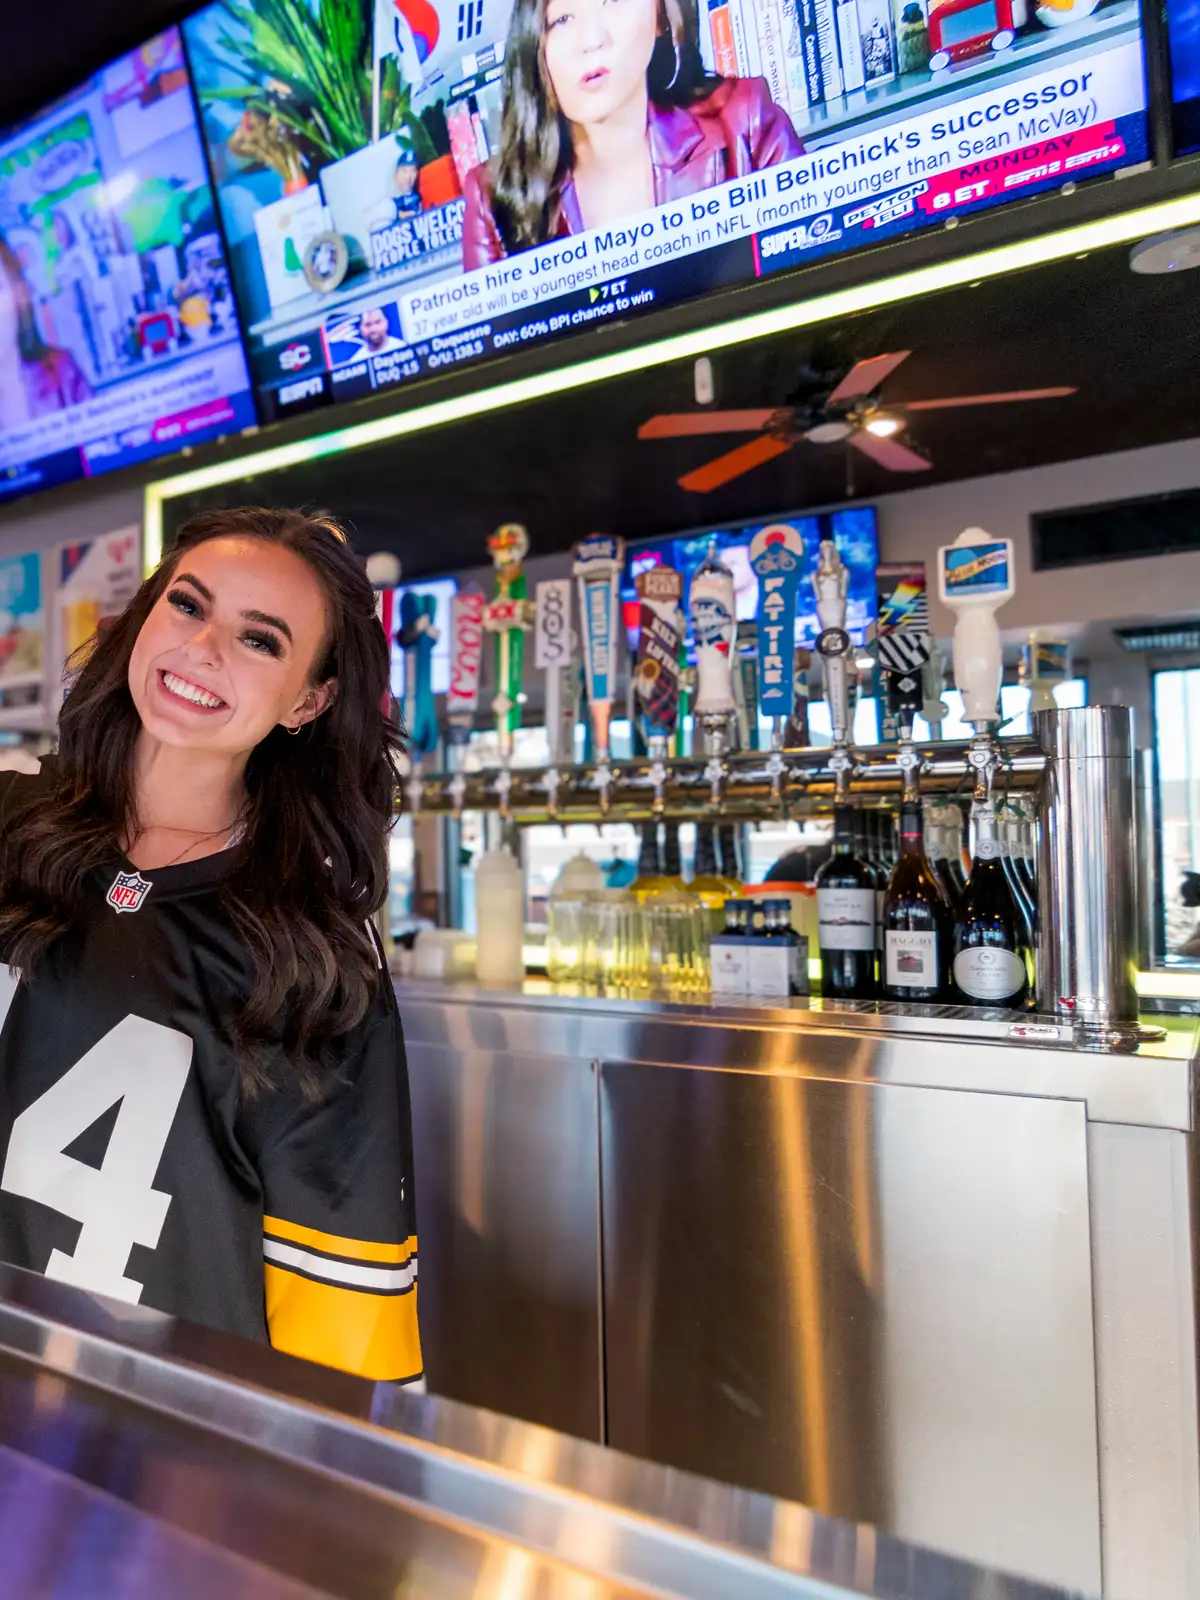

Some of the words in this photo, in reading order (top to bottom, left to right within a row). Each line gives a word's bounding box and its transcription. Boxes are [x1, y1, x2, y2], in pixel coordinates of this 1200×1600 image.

[959, 134, 1076, 181] MONDAY
[410, 282, 480, 315] Patriots
[486, 268, 522, 291] hire
[529, 241, 587, 275] Jerod
[594, 223, 654, 253] Mayo
[661, 212, 684, 231] to
[691, 200, 720, 220] be
[728, 178, 767, 208] Bill
[776, 132, 921, 192] Belichick's
[931, 71, 1092, 140] successor
[848, 182, 926, 223] PEYTON
[932, 192, 952, 209] 8
[955, 179, 990, 204] ET
[1004, 159, 1061, 188] ESPN2
[372, 222, 414, 253] DOGS
[413, 200, 466, 239] WELCO
[413, 319, 429, 336] 37
[433, 311, 458, 332] year
[462, 302, 483, 320] old
[486, 294, 508, 312] will
[511, 288, 529, 303] be
[532, 264, 598, 300] youngest
[601, 251, 639, 276] head
[644, 233, 691, 261] coach
[696, 228, 711, 244] in
[717, 213, 751, 237] NFL
[756, 189, 818, 226] (month
[823, 166, 901, 210] younger
[907, 150, 950, 176] than
[958, 131, 1010, 159] Sean
[1018, 98, 1098, 141] McVay)
[879, 203, 909, 223] ELI
[375, 239, 421, 270] PEOPLE
[423, 226, 464, 253] TOLER
[760, 224, 808, 258] SUPER
[601, 285, 610, 299] 7
[611, 279, 627, 296] ET
[493, 331, 519, 349] DAY:
[520, 321, 549, 341] 60%
[549, 314, 570, 332] BPI
[572, 301, 615, 323] chance
[616, 297, 629, 311] to
[631, 288, 653, 306] win
[279, 342, 312, 372] SC
[374, 349, 414, 371] Dayton
[431, 324, 492, 352] Duquesne
[278, 376, 324, 405] ESPN
[376, 367, 401, 385] DUQ
[489, 601, 517, 620] XX
[763, 576, 786, 621] FAT
[763, 625, 785, 684] TIRE
[111, 885, 138, 907] NFL
